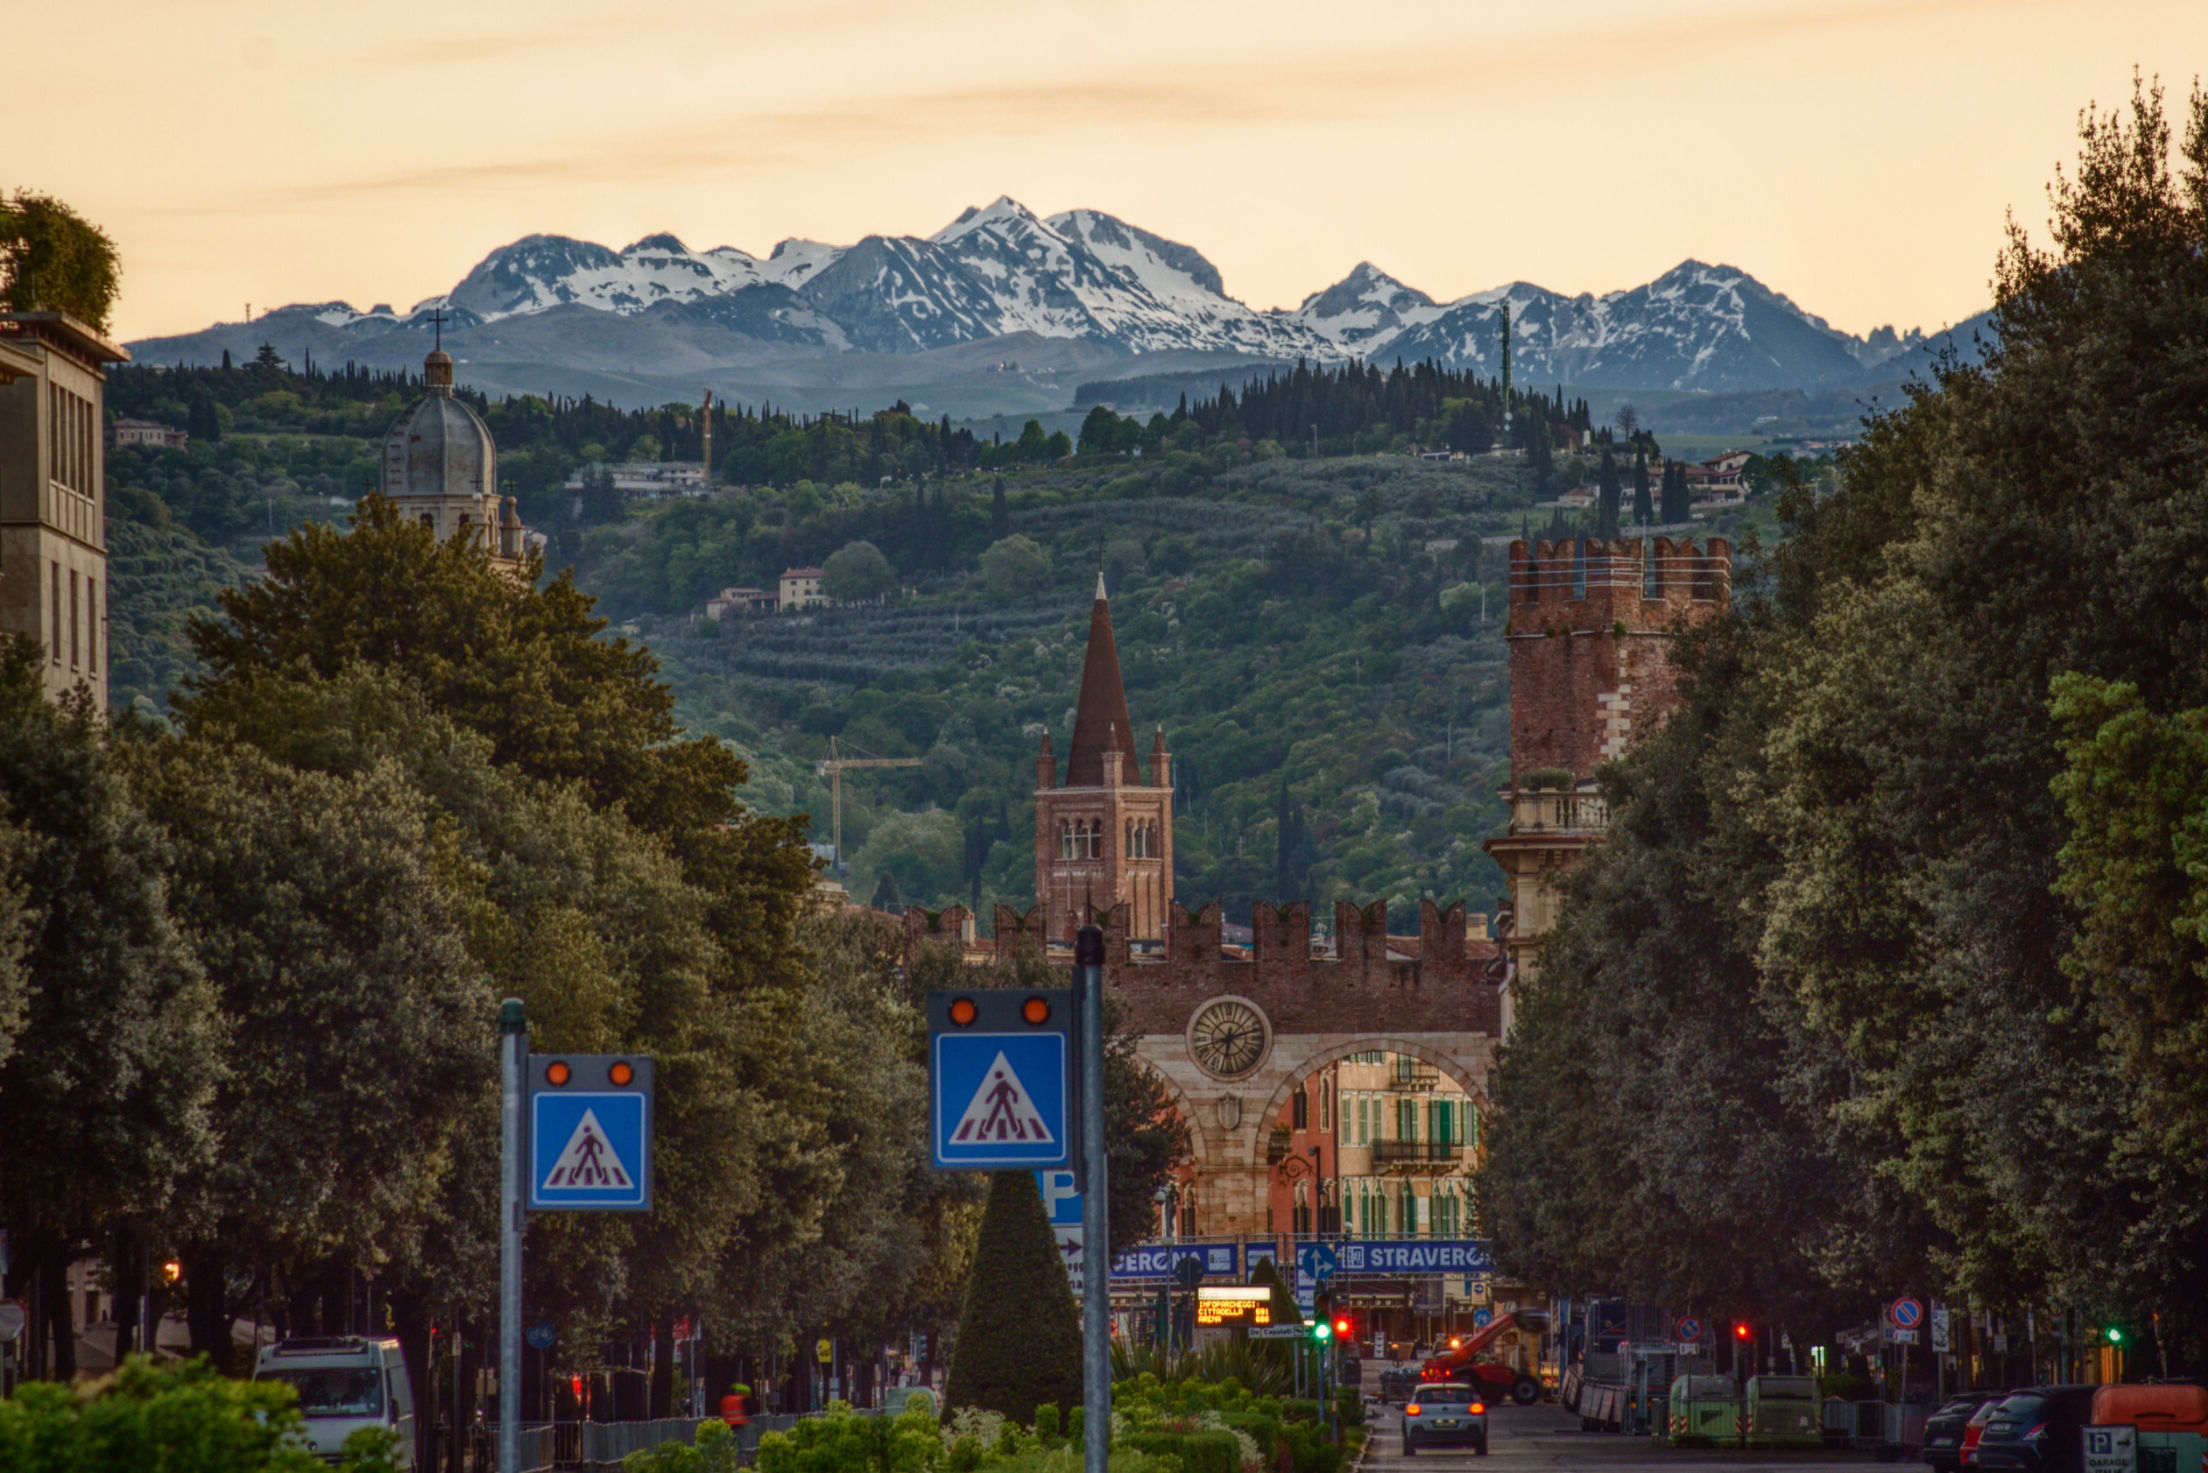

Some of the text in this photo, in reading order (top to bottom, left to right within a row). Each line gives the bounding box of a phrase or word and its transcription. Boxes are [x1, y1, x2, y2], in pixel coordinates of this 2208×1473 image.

[1043, 1170, 1079, 1218] P
[1371, 1248, 1497, 1266] STRAVERO
[1198, 1308, 1243, 1316] CITTADELLA
[1198, 1315, 1222, 1323] ARENA
[2094, 1434, 2108, 1452] P
[2089, 1459, 2128, 1467] GARAGE
